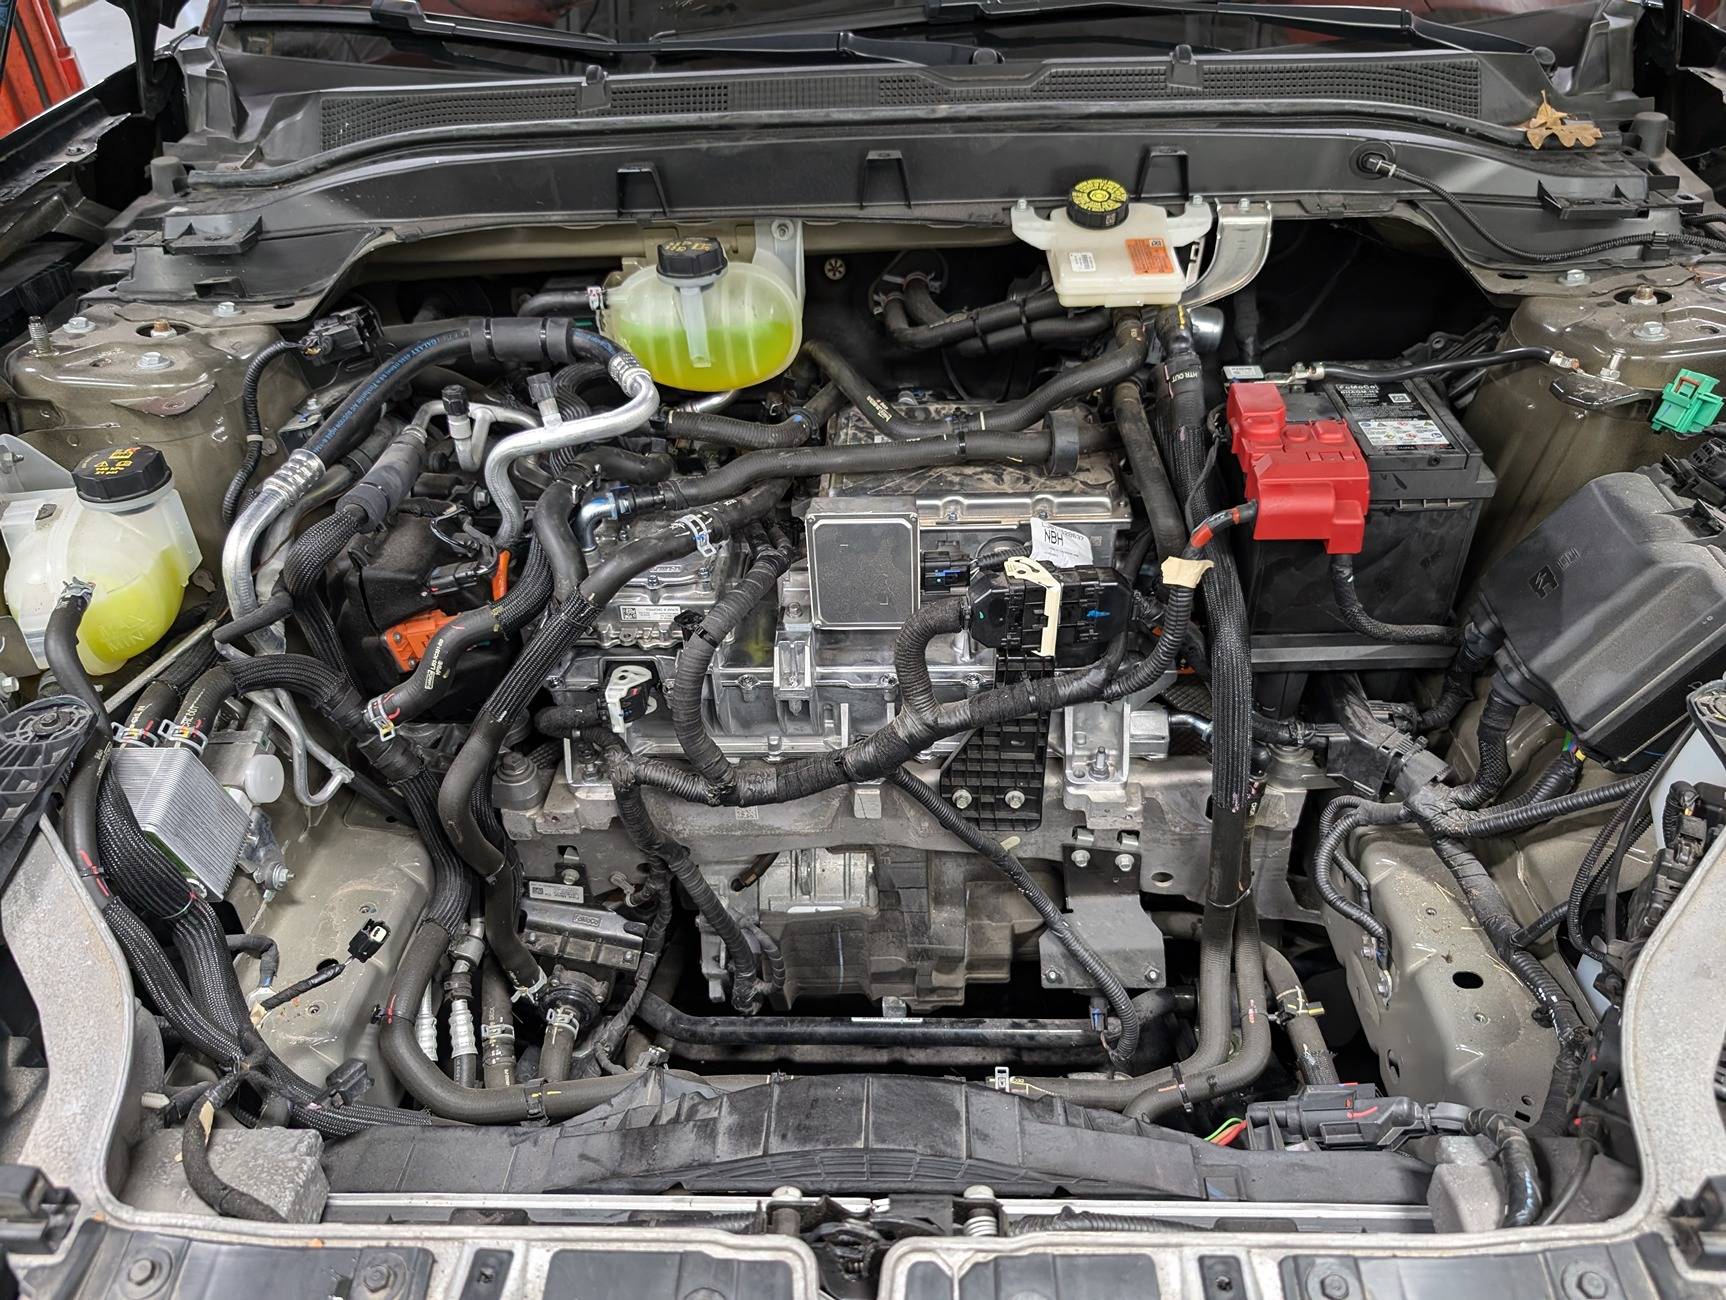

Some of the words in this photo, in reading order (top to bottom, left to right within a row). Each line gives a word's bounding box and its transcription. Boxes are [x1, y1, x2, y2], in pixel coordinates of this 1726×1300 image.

[1172, 373, 1185, 383] OUT
[1185, 371, 1198, 379] HTR
[1044, 529, 1064, 547] NBH
